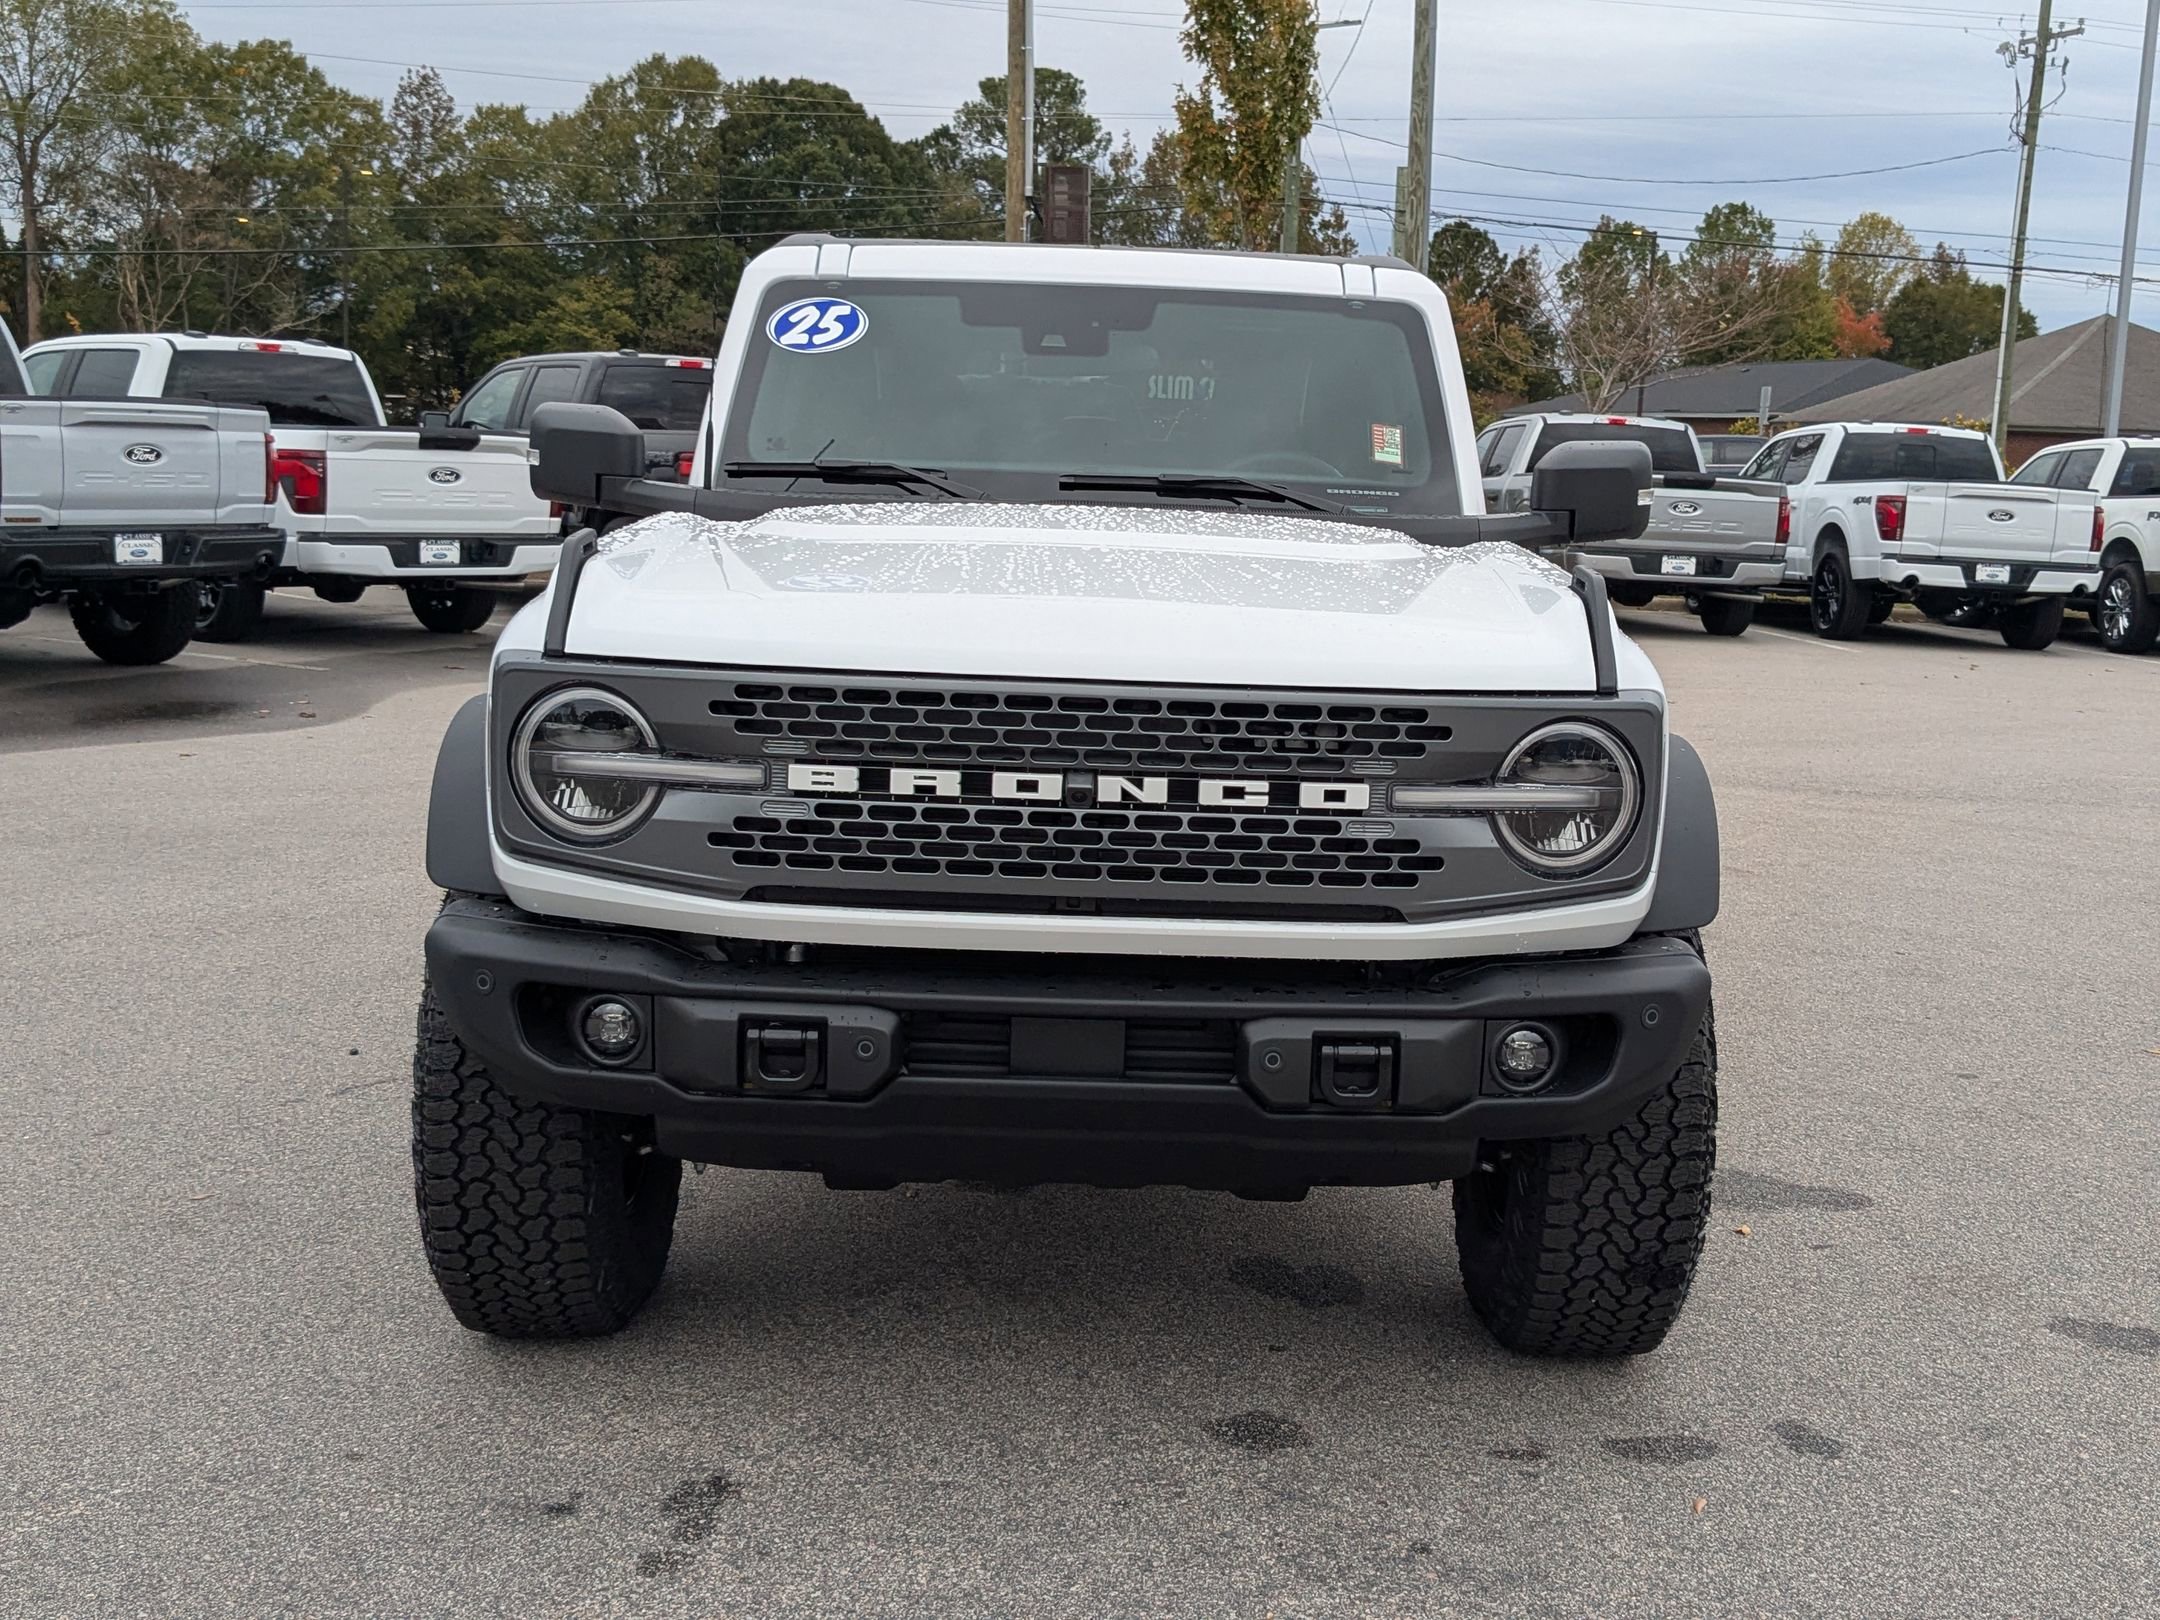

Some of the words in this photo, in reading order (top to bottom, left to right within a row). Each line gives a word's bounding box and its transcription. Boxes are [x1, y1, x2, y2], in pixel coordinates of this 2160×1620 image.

[779, 305, 852, 346] 25
[75, 470, 210, 488] F-150
[787, 763, 1370, 810] BRONCO
